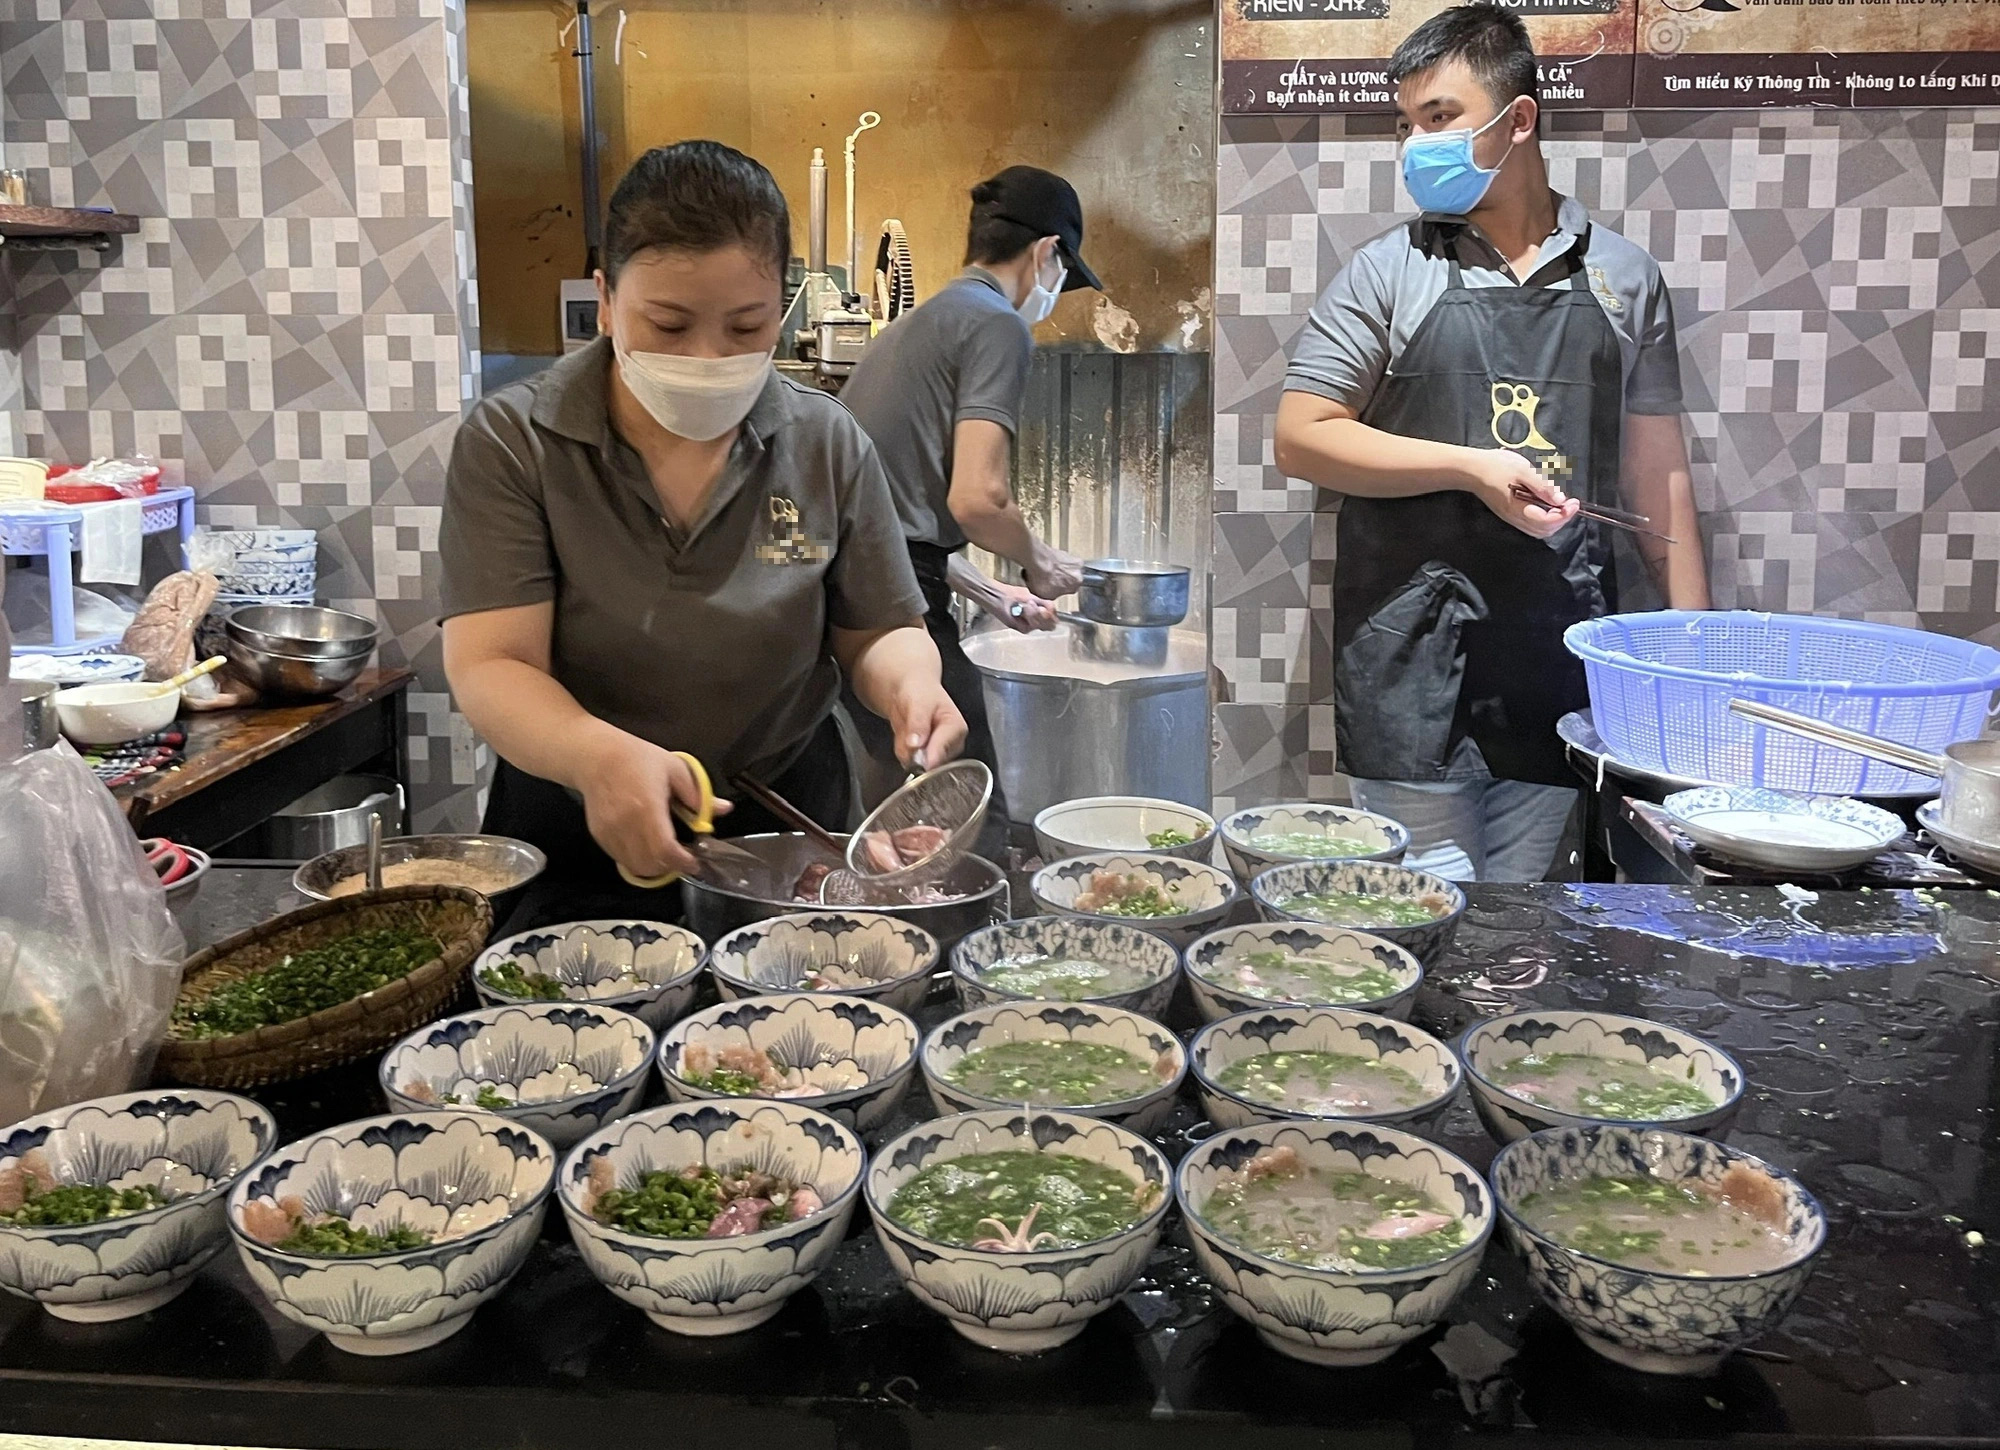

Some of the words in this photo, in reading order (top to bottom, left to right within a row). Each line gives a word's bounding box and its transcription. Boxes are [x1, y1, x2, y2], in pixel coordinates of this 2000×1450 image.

[1280, 66, 1317, 85] CHẤT
[1319, 72, 1336, 85] và
[1341, 71, 1388, 88] LƯỢNG
[1663, 75, 1691, 91] Tìm
[1696, 72, 1729, 89] Hiểu
[1734, 75, 1753, 92] Kỹ
[1756, 75, 1803, 91] Thông
[1845, 75, 1894, 91] Không
[1899, 76, 1915, 88] Lo
[1920, 71, 1956, 90] Lắng
[1961, 74, 1987, 87] Khi
[1267, 91, 1295, 107] Bạn
[1298, 89, 1334, 106] nhận
[1339, 89, 1350, 102] ít
[1354, 89, 1390, 102] chưa
[1542, 82, 1584, 99] nhiều
